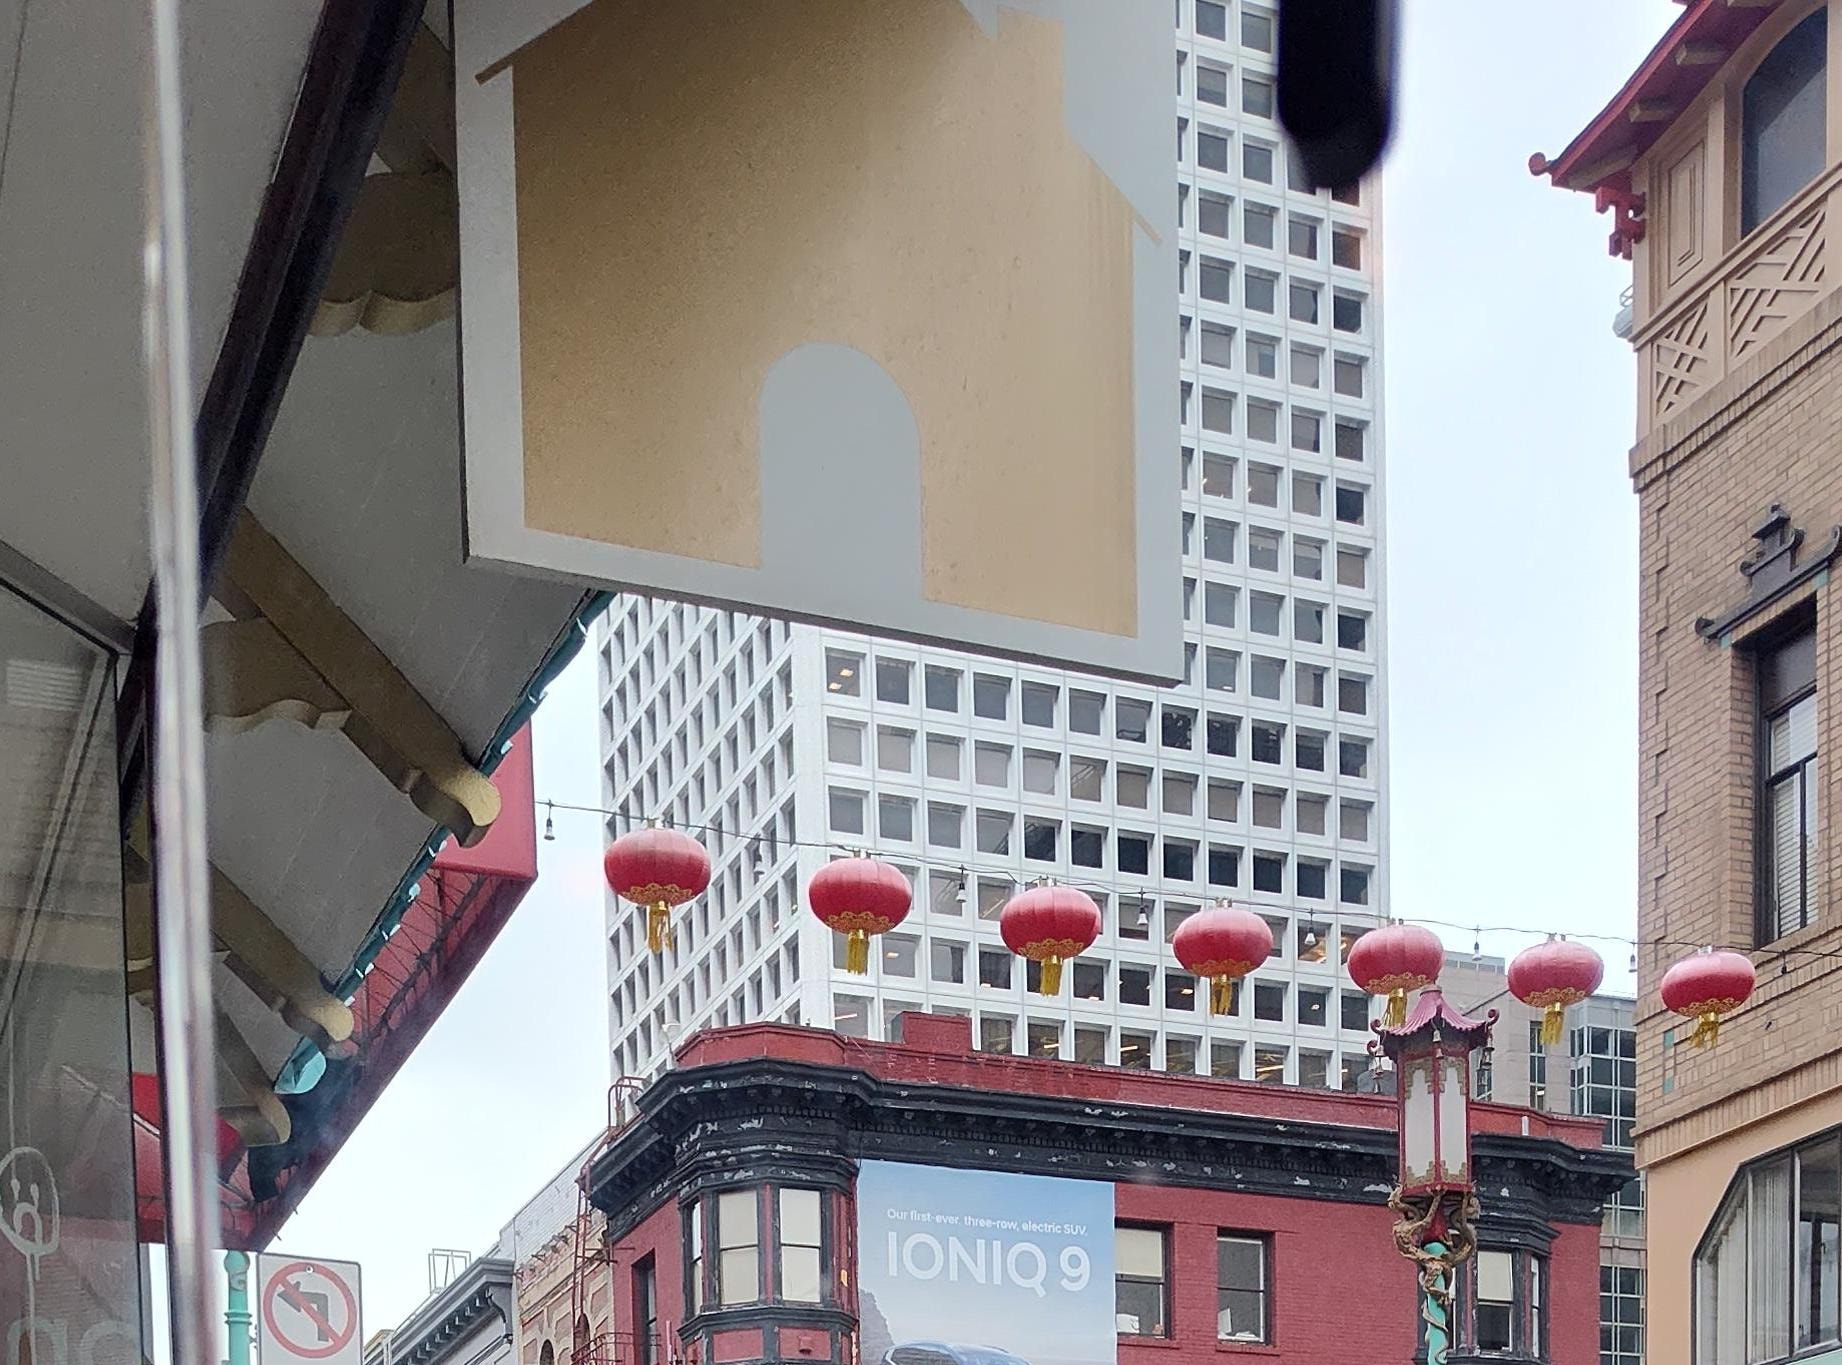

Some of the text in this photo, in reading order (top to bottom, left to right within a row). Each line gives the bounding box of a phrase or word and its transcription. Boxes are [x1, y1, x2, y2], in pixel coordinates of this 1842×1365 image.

[887, 1208, 908, 1220] Our
[964, 1215, 1019, 1231] three-row,
[1022, 1220, 1062, 1234] electric
[1063, 1223, 1088, 1236] SUV.
[888, 1231, 1091, 1298] IONIQ 9
